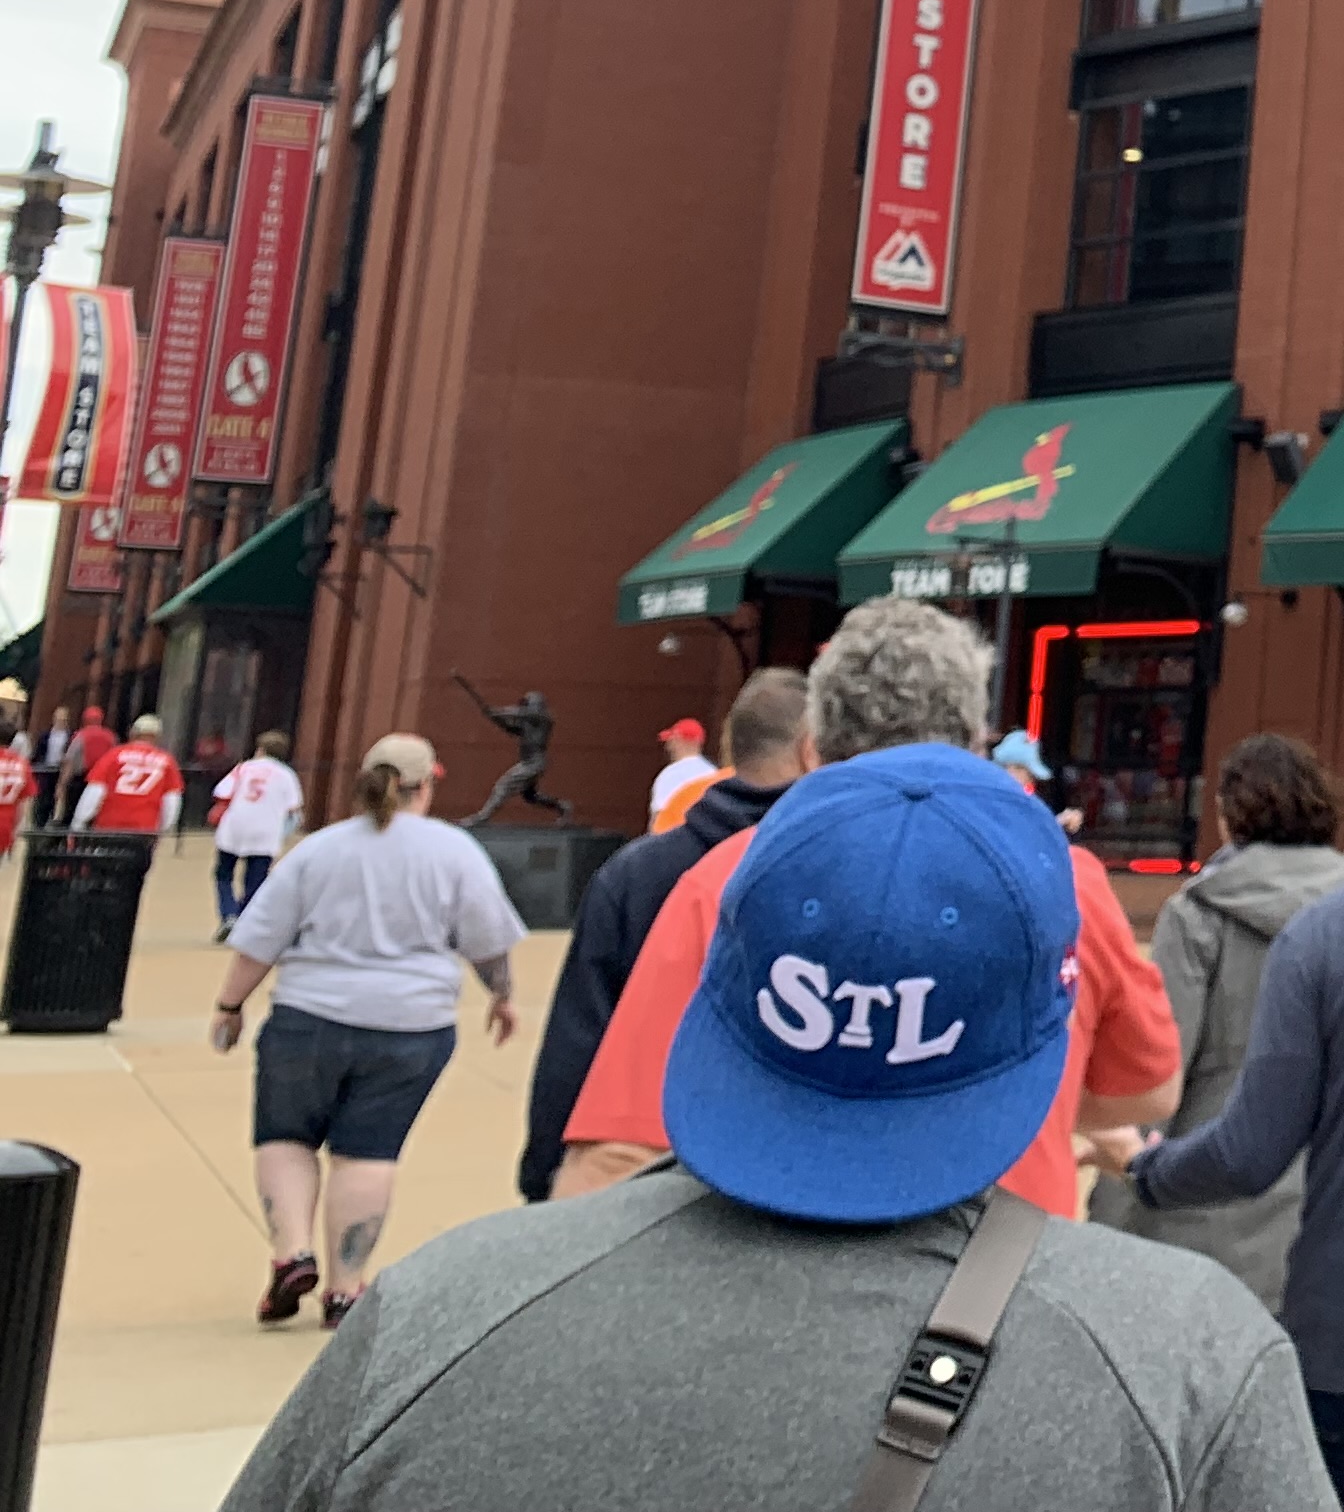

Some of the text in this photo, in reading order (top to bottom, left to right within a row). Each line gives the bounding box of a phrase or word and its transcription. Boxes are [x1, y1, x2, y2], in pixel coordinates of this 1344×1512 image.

[59, 386, 95, 488] STORE
[890, 568, 952, 597] TEAM
[114, 766, 165, 796] 27
